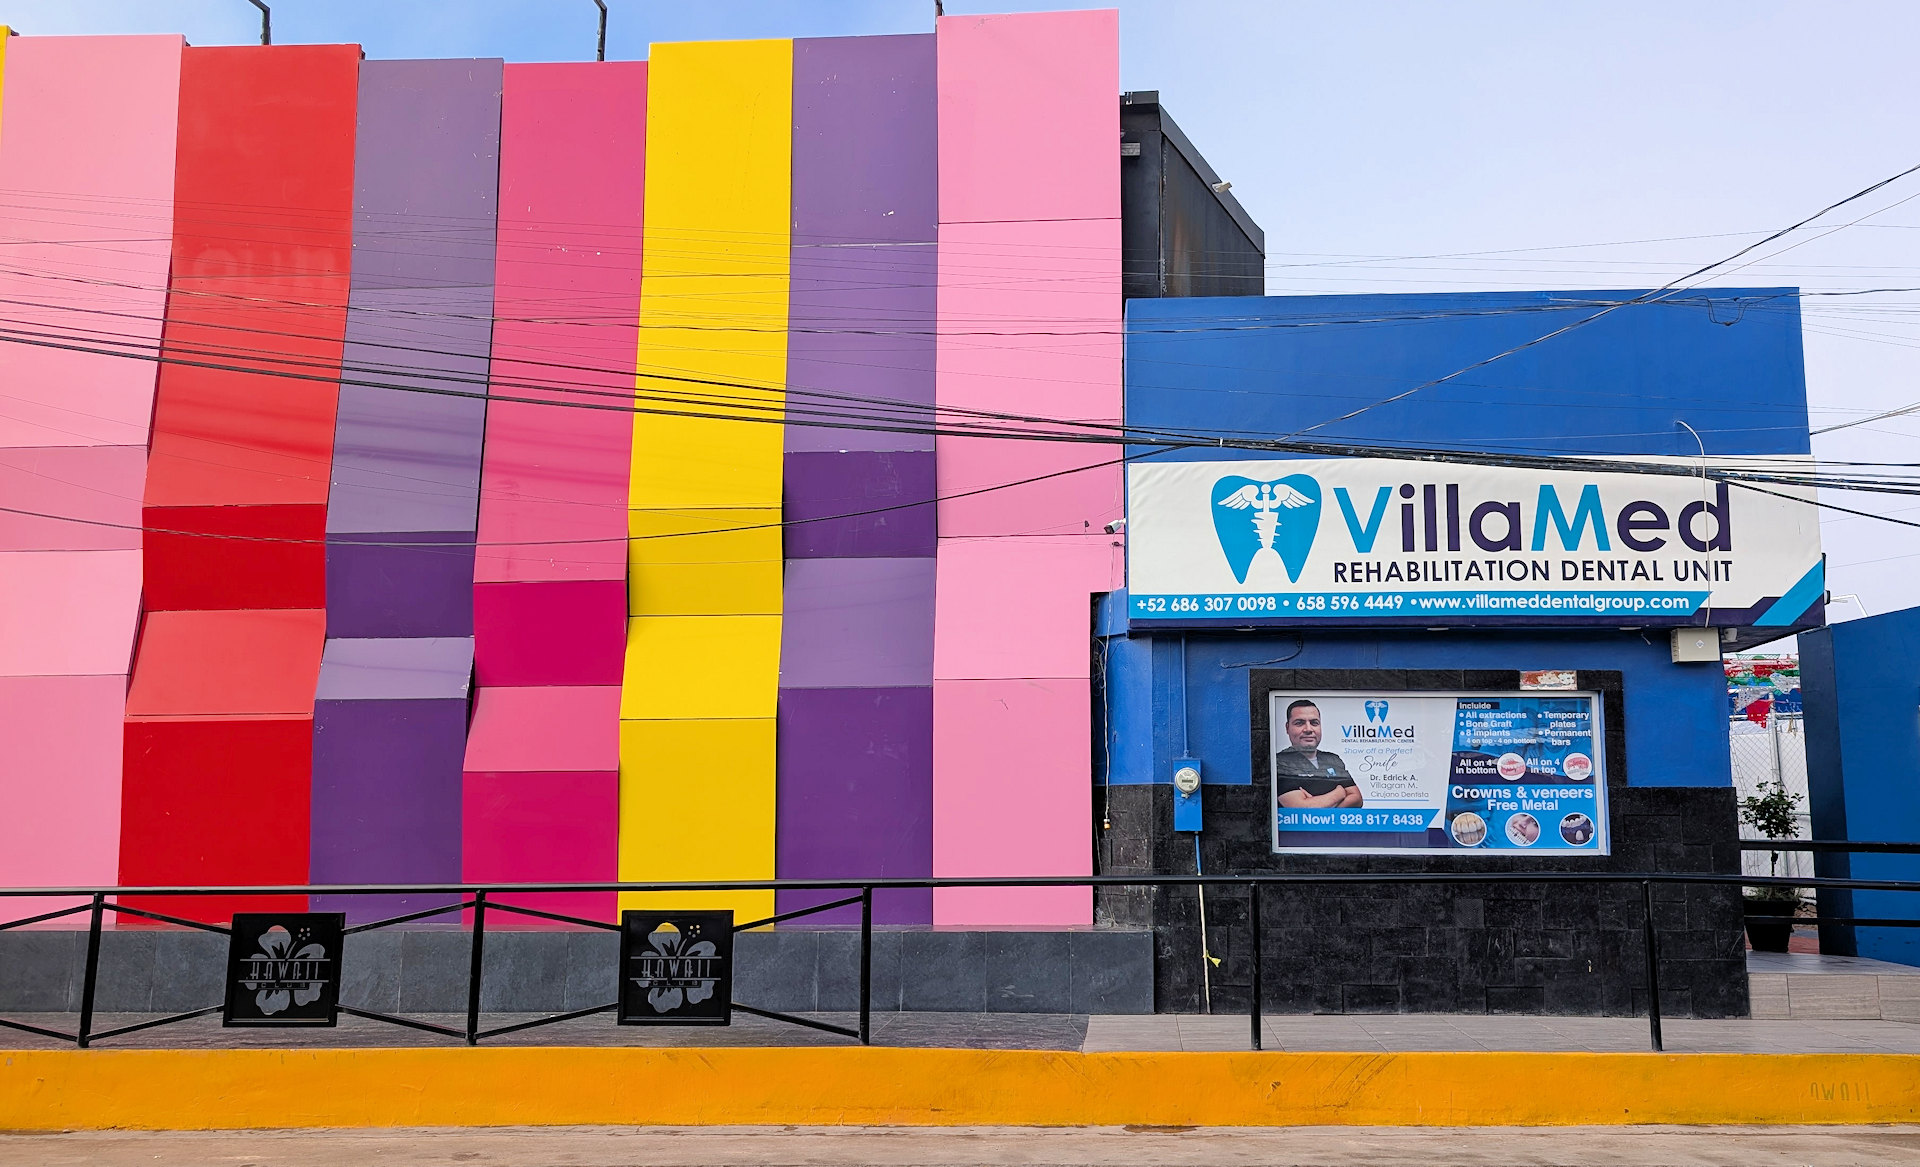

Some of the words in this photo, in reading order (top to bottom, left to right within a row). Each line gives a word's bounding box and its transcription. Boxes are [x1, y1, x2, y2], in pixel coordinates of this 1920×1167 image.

[1333, 482, 1732, 553] VillaMed
[1334, 560, 1550, 583] REHABILITATION
[1562, 560, 1664, 582] DENTAL
[1673, 560, 1733, 582] UNIT
[1137, 598, 1166, 612] +52
[1170, 598, 1200, 612] 686
[1204, 597, 1234, 611] 307
[1237, 597, 1276, 611] 0098
[1296, 597, 1326, 610] 658
[1330, 596, 1360, 610] 596
[1364, 596, 1403, 610] 4449
[1418, 594, 1690, 612] www.villameddentalgroup.com
[1466, 711, 1477, 719] All
[1479, 711, 1527, 719] extractions
[1543, 711, 1590, 720] Temporary
[1466, 720, 1489, 728] Bone
[1491, 720, 1512, 728] Graft
[1550, 721, 1576, 729] plates
[1341, 725, 1415, 738] VillaMed
[1544, 729, 1592, 737] Permanent
[1552, 738, 1571, 746] bars
[1359, 753, 1398, 772] Smile
[1542, 766, 1556, 775] top
[1370, 782, 1406, 790] Villagran
[1452, 786, 1511, 799] Crowns
[1516, 786, 1527, 799] &
[1531, 787, 1593, 799] veneers
[1487, 800, 1518, 811] Free
[1522, 799, 1558, 811] Metal
[1278, 814, 1298, 825] Call
[1302, 814, 1334, 825] Now!
[1340, 814, 1363, 825] 928
[1366, 814, 1389, 825] 817
[1393, 814, 1423, 825] 8438
[250, 962, 318, 979] HAWAII
[641, 959, 711, 977] HAWAII
